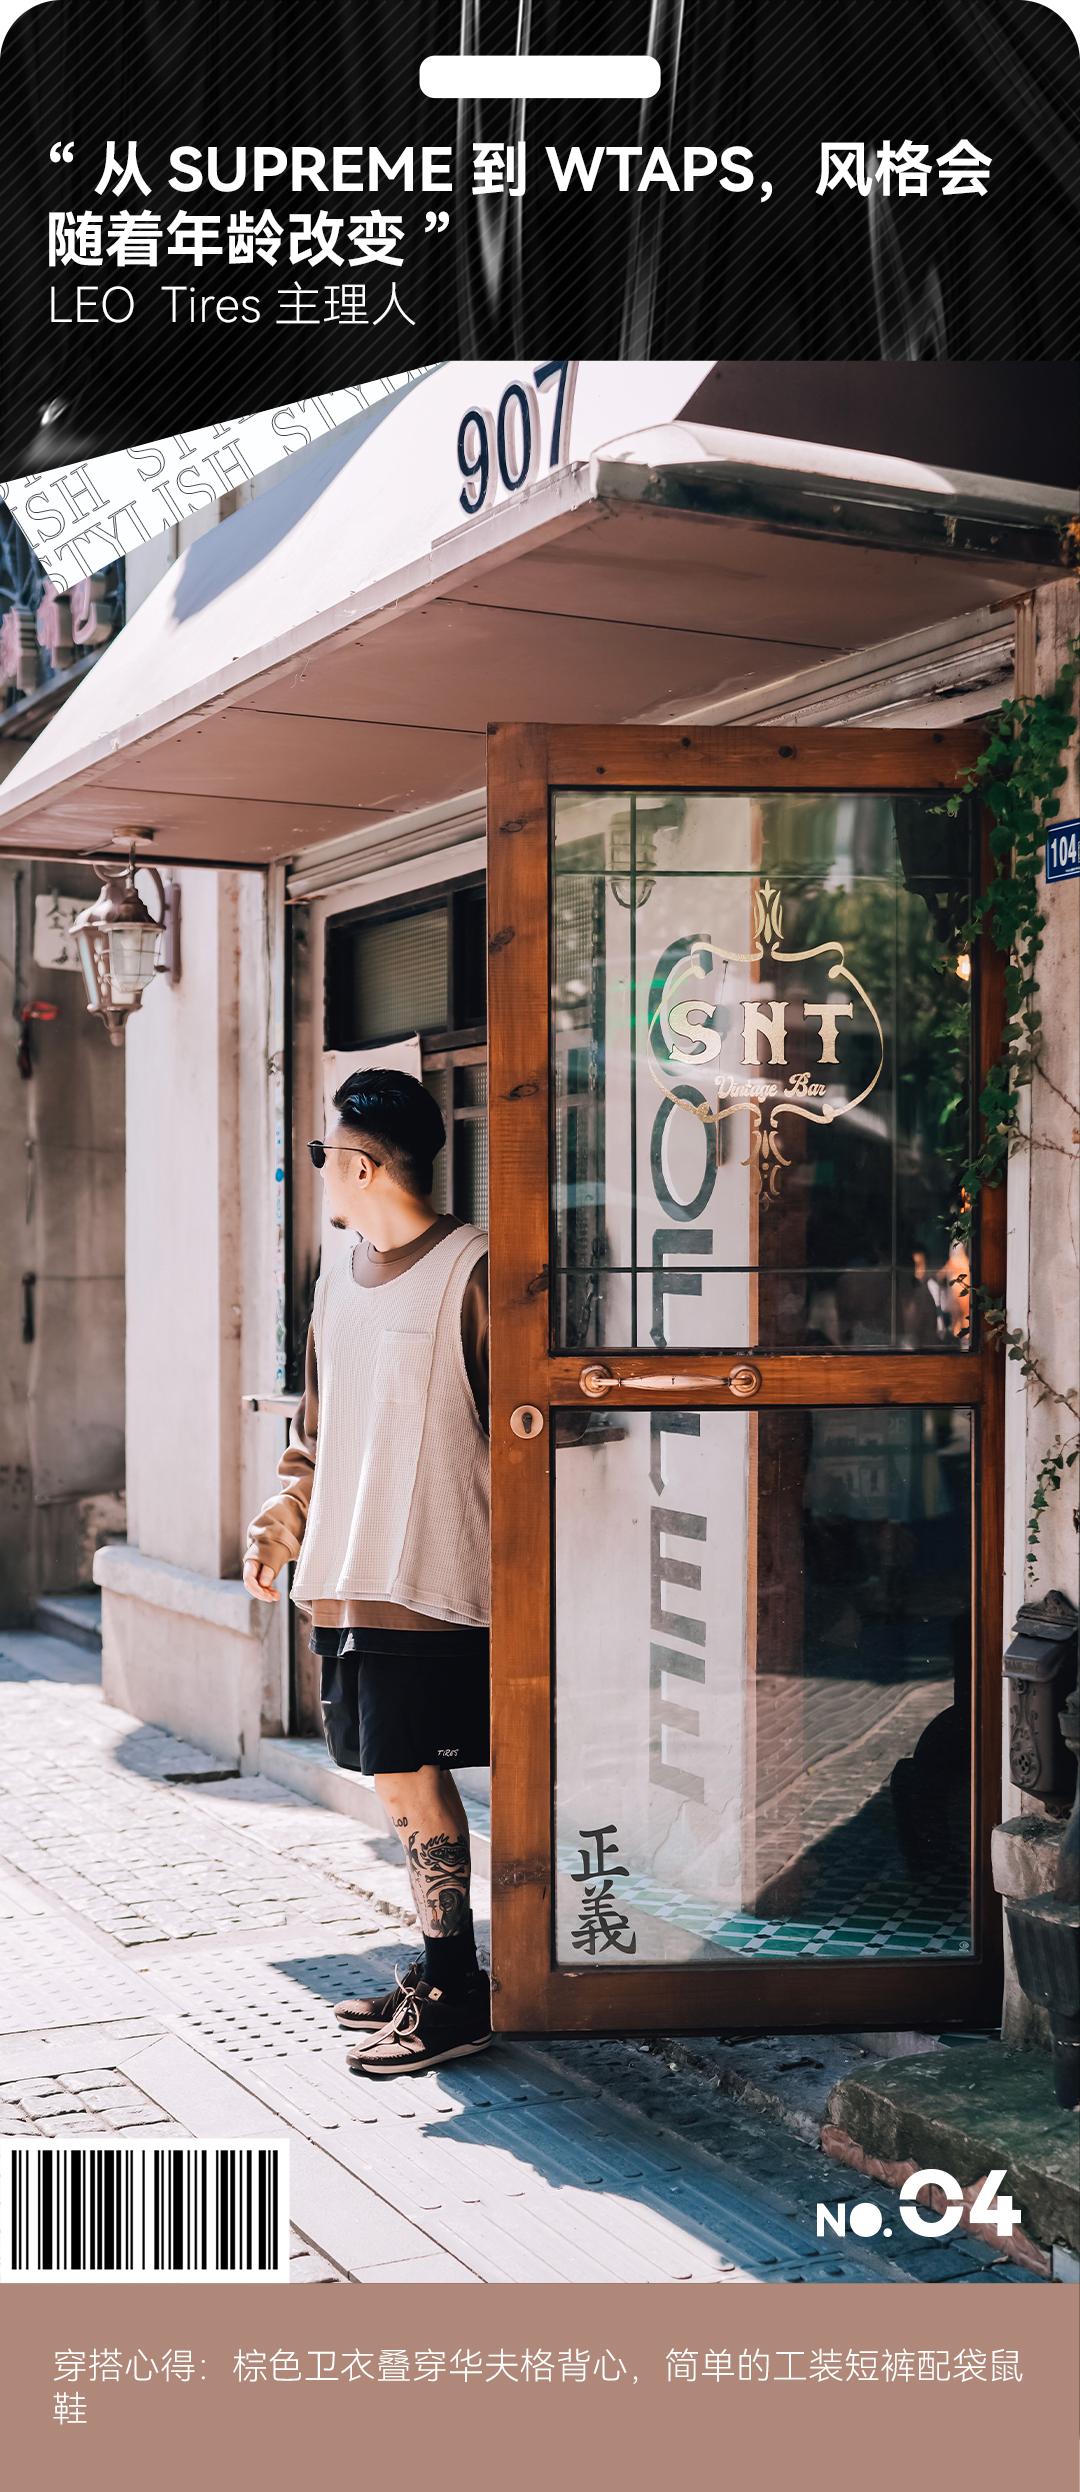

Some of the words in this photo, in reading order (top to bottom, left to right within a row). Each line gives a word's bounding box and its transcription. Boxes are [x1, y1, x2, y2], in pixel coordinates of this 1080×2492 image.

[457, 360, 572, 514] 907
[1050, 833, 1080, 868] 104
[668, 1000, 854, 1066] SNT
[714, 1074, 779, 1103] Vintage
[783, 1071, 827, 1098] Bar
[570, 1824, 637, 1956] 正義
